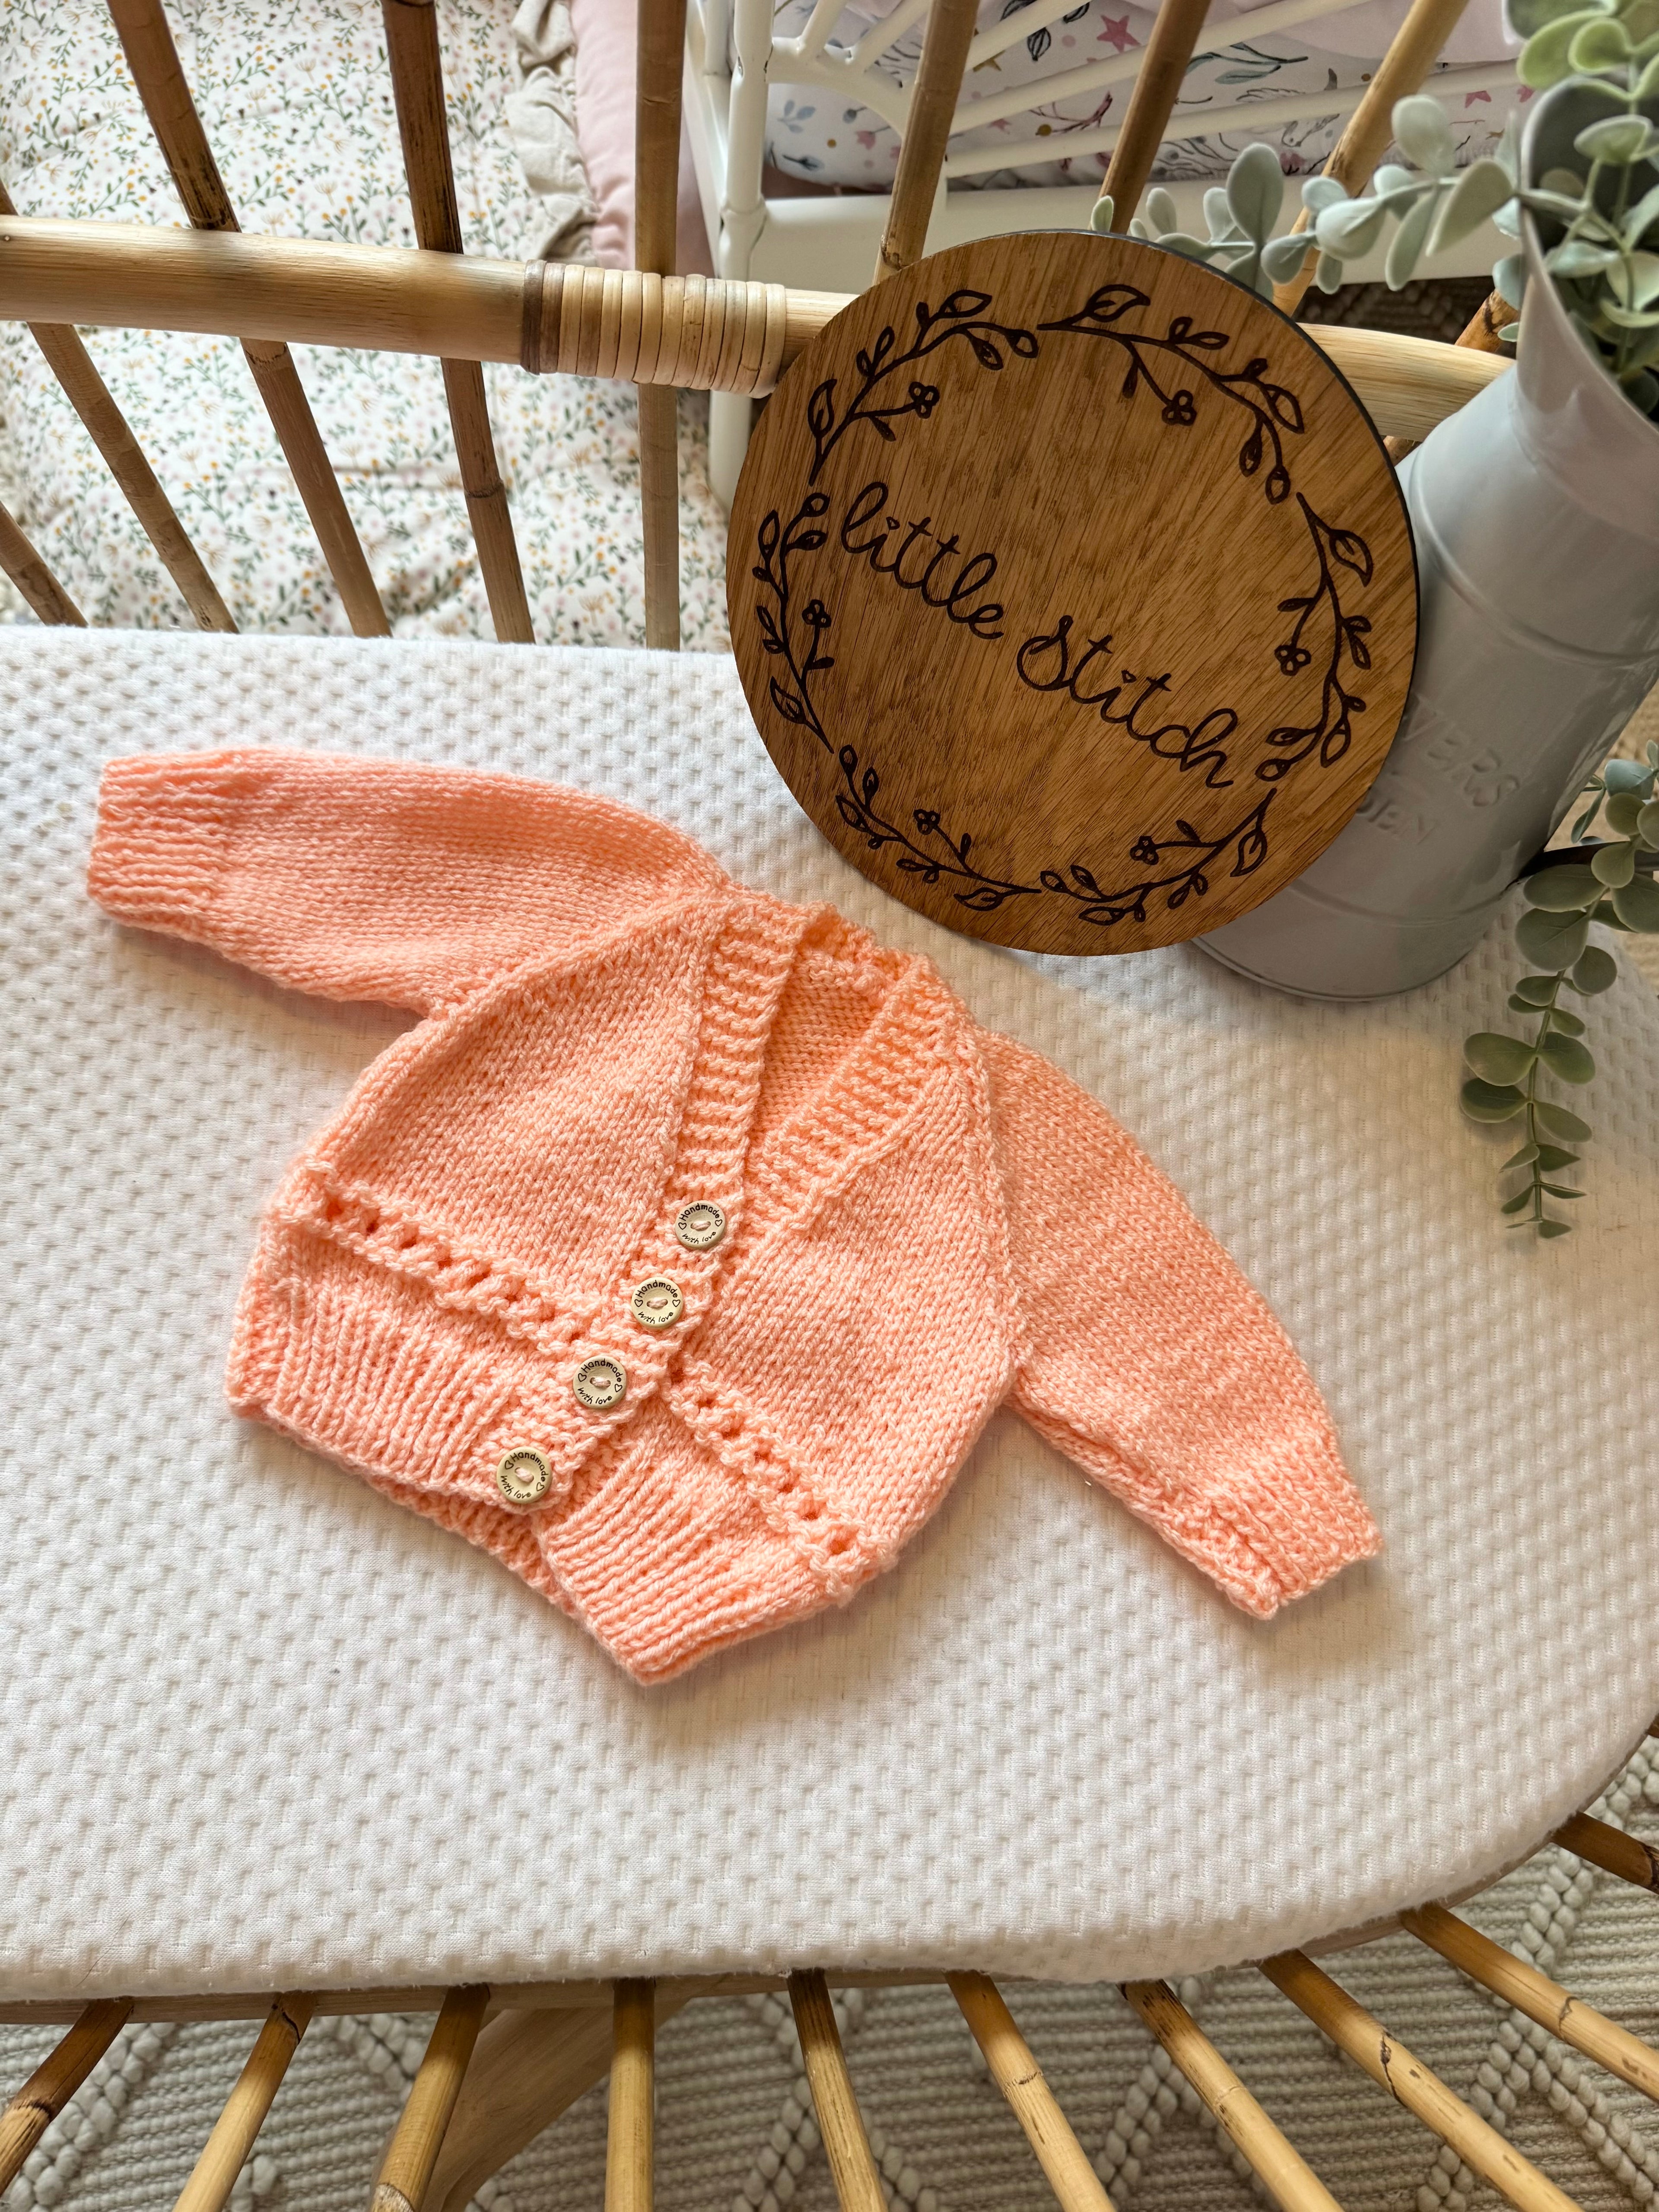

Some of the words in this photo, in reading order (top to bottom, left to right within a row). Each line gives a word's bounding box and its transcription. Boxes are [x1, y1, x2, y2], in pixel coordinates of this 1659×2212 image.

[679, 1203, 720, 1221] Handmade
[702, 1231, 716, 1242] love
[635, 1280, 678, 1298] Handmade
[658, 1312, 674, 1322] love
[581, 1358, 623, 1382] Handmade
[595, 1395, 613, 1405] love
[510, 1452, 549, 1482] Handmade
[514, 1490, 532, 1499] love
